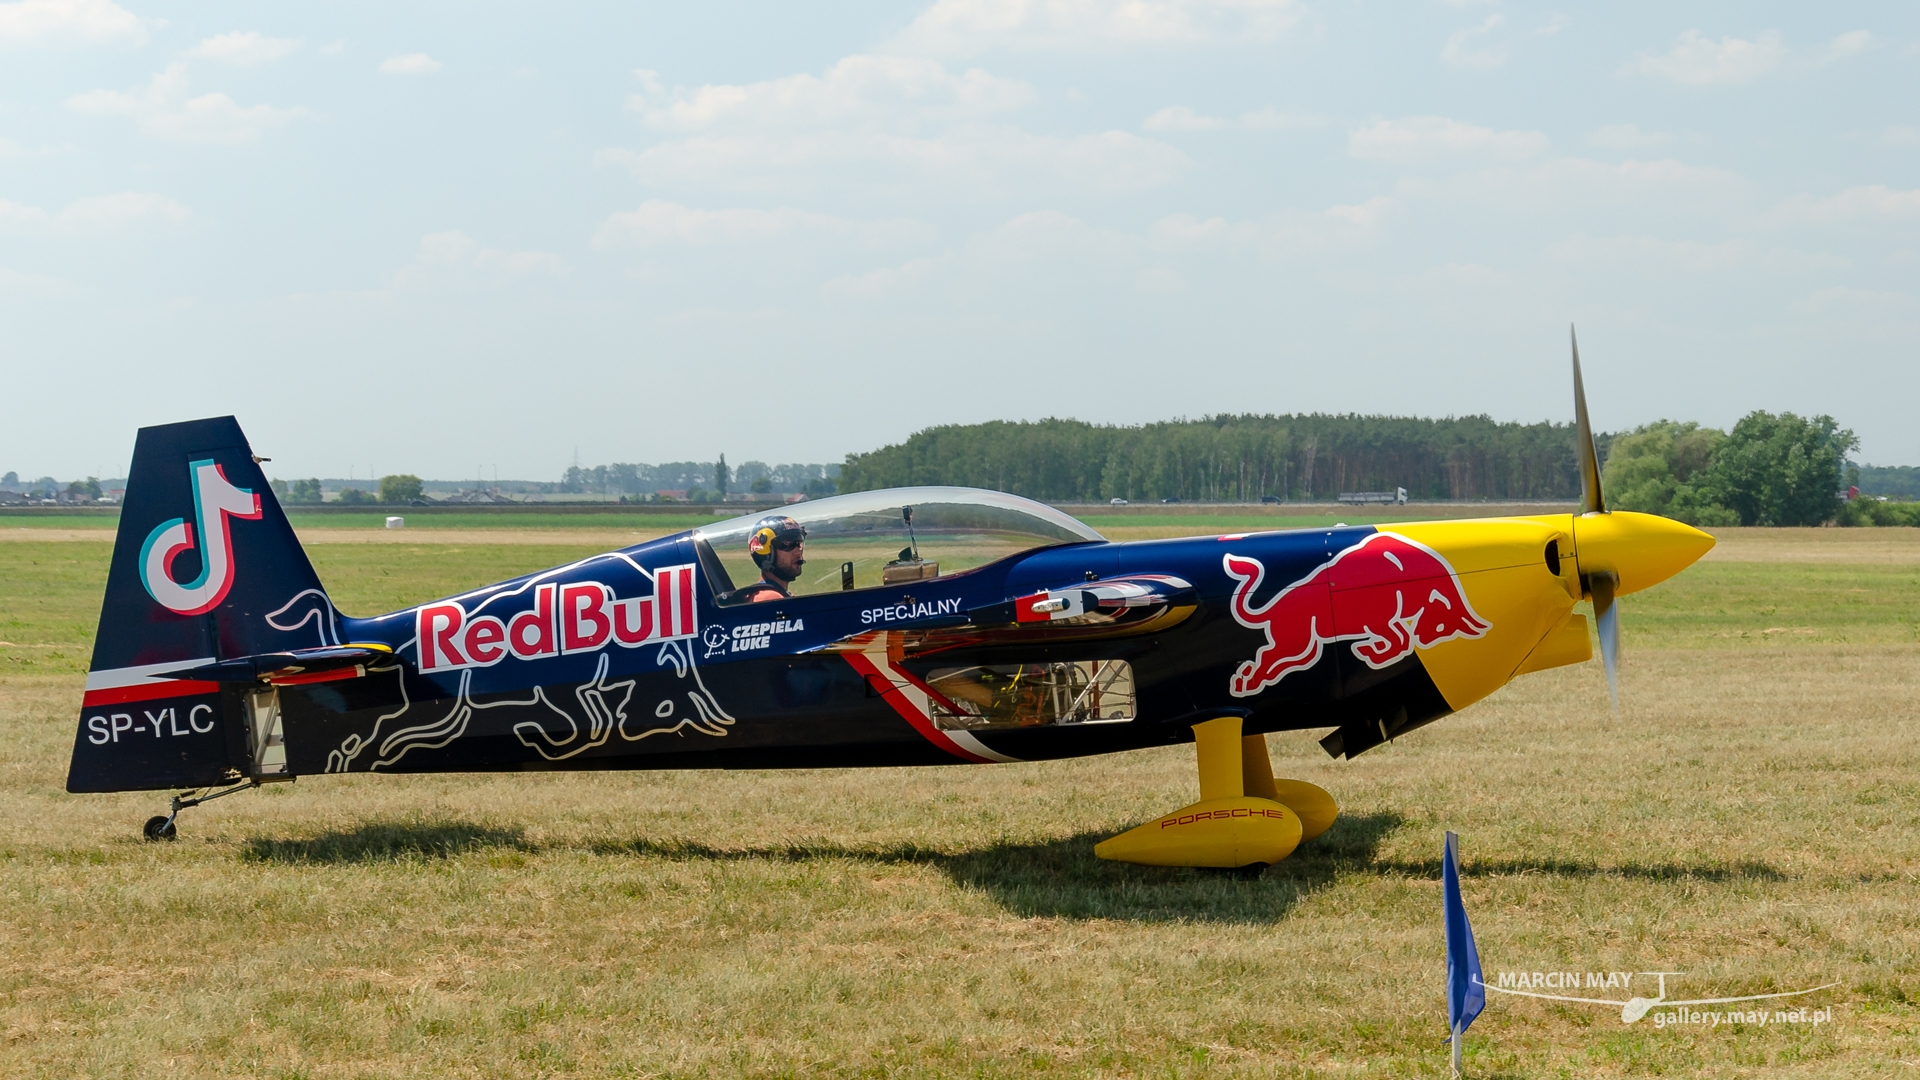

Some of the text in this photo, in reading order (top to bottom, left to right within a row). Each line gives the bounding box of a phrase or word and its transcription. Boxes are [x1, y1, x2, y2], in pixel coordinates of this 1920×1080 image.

[861, 598, 961, 624] SPECJALNY
[731, 619, 804, 639] CZEPIELA
[731, 636, 770, 652] LUKE
[88, 704, 214, 744] SP-YLC
[1161, 809, 1283, 829] PORSCHE
